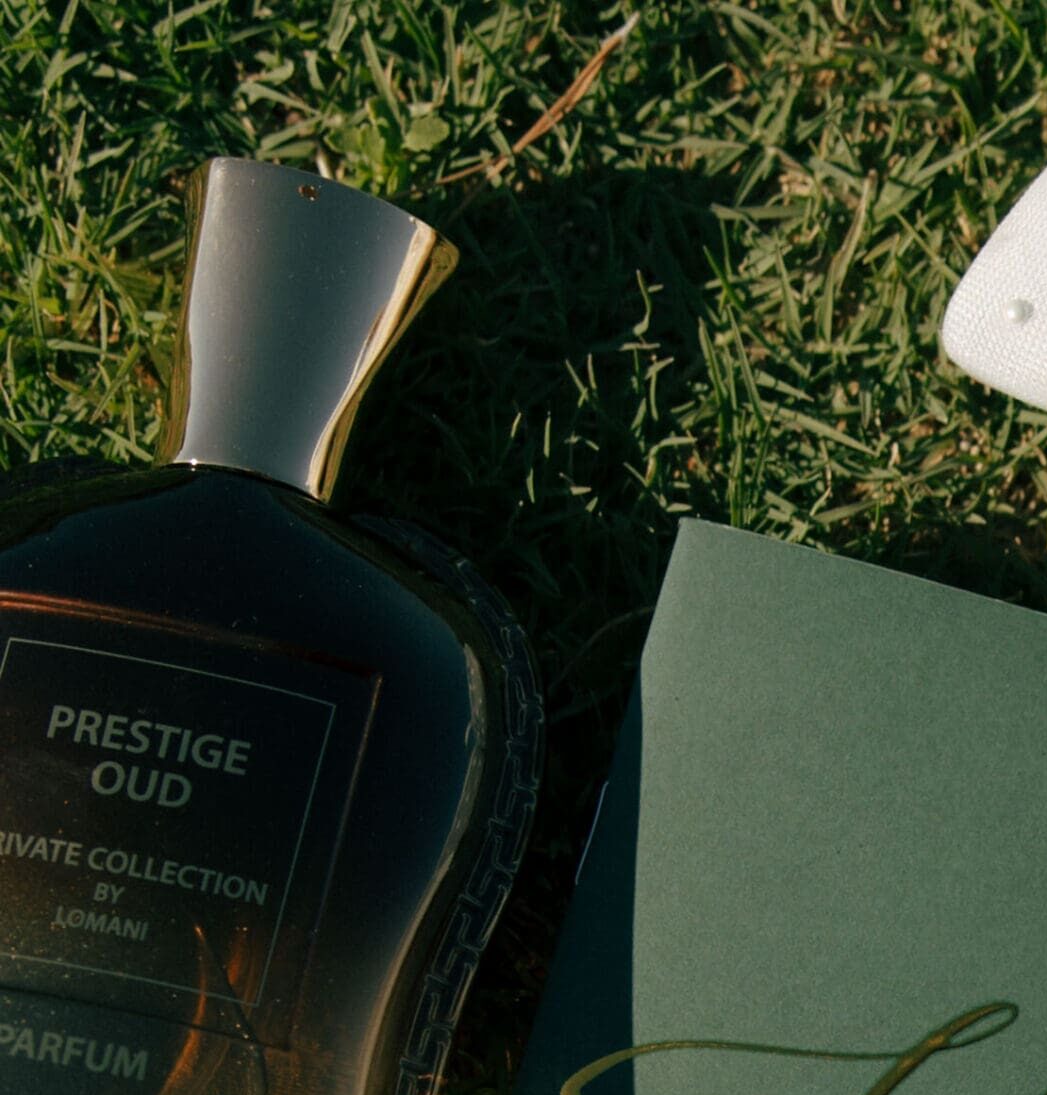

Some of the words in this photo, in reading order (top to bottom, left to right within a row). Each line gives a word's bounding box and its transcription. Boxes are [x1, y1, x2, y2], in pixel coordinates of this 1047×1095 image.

[47, 705, 251, 775] PRESTIGE
[91, 760, 192, 808] OUD
[87, 846, 268, 905] COLLECTION
[93, 881, 126, 904] BY
[55, 906, 148, 941] LOMANI
[0, 1024, 149, 1081] PARFUM
